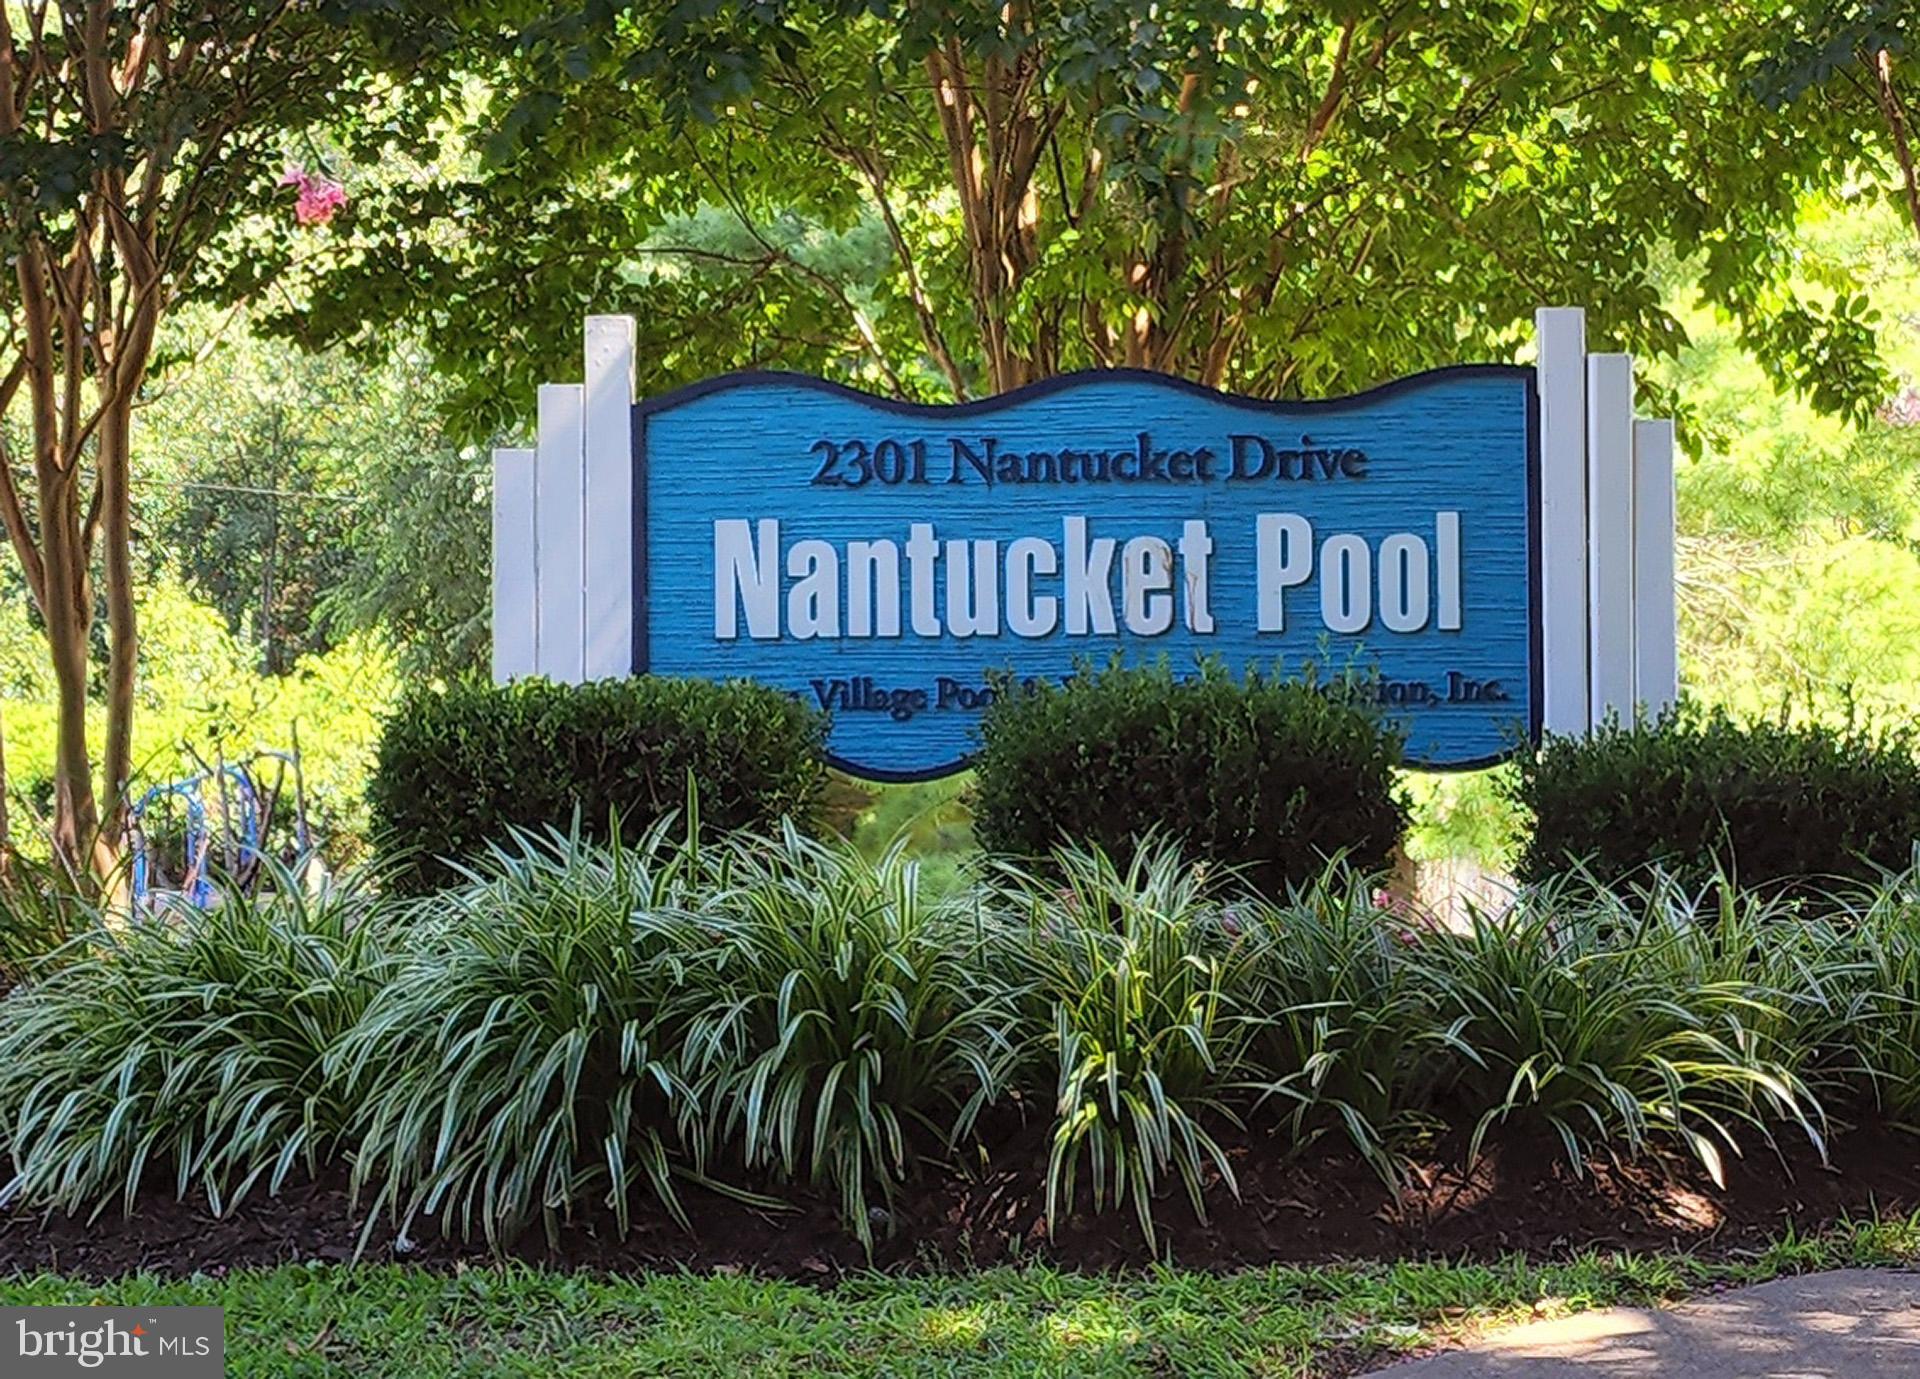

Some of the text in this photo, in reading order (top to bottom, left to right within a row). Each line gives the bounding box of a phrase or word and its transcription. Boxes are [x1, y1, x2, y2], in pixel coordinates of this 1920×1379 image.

[809, 431, 1369, 488] 2301 Nantucket Drive
[713, 510, 1462, 640] Nantucket Pool
[809, 675, 929, 721] Village
[1445, 669, 1509, 704] Inc.
